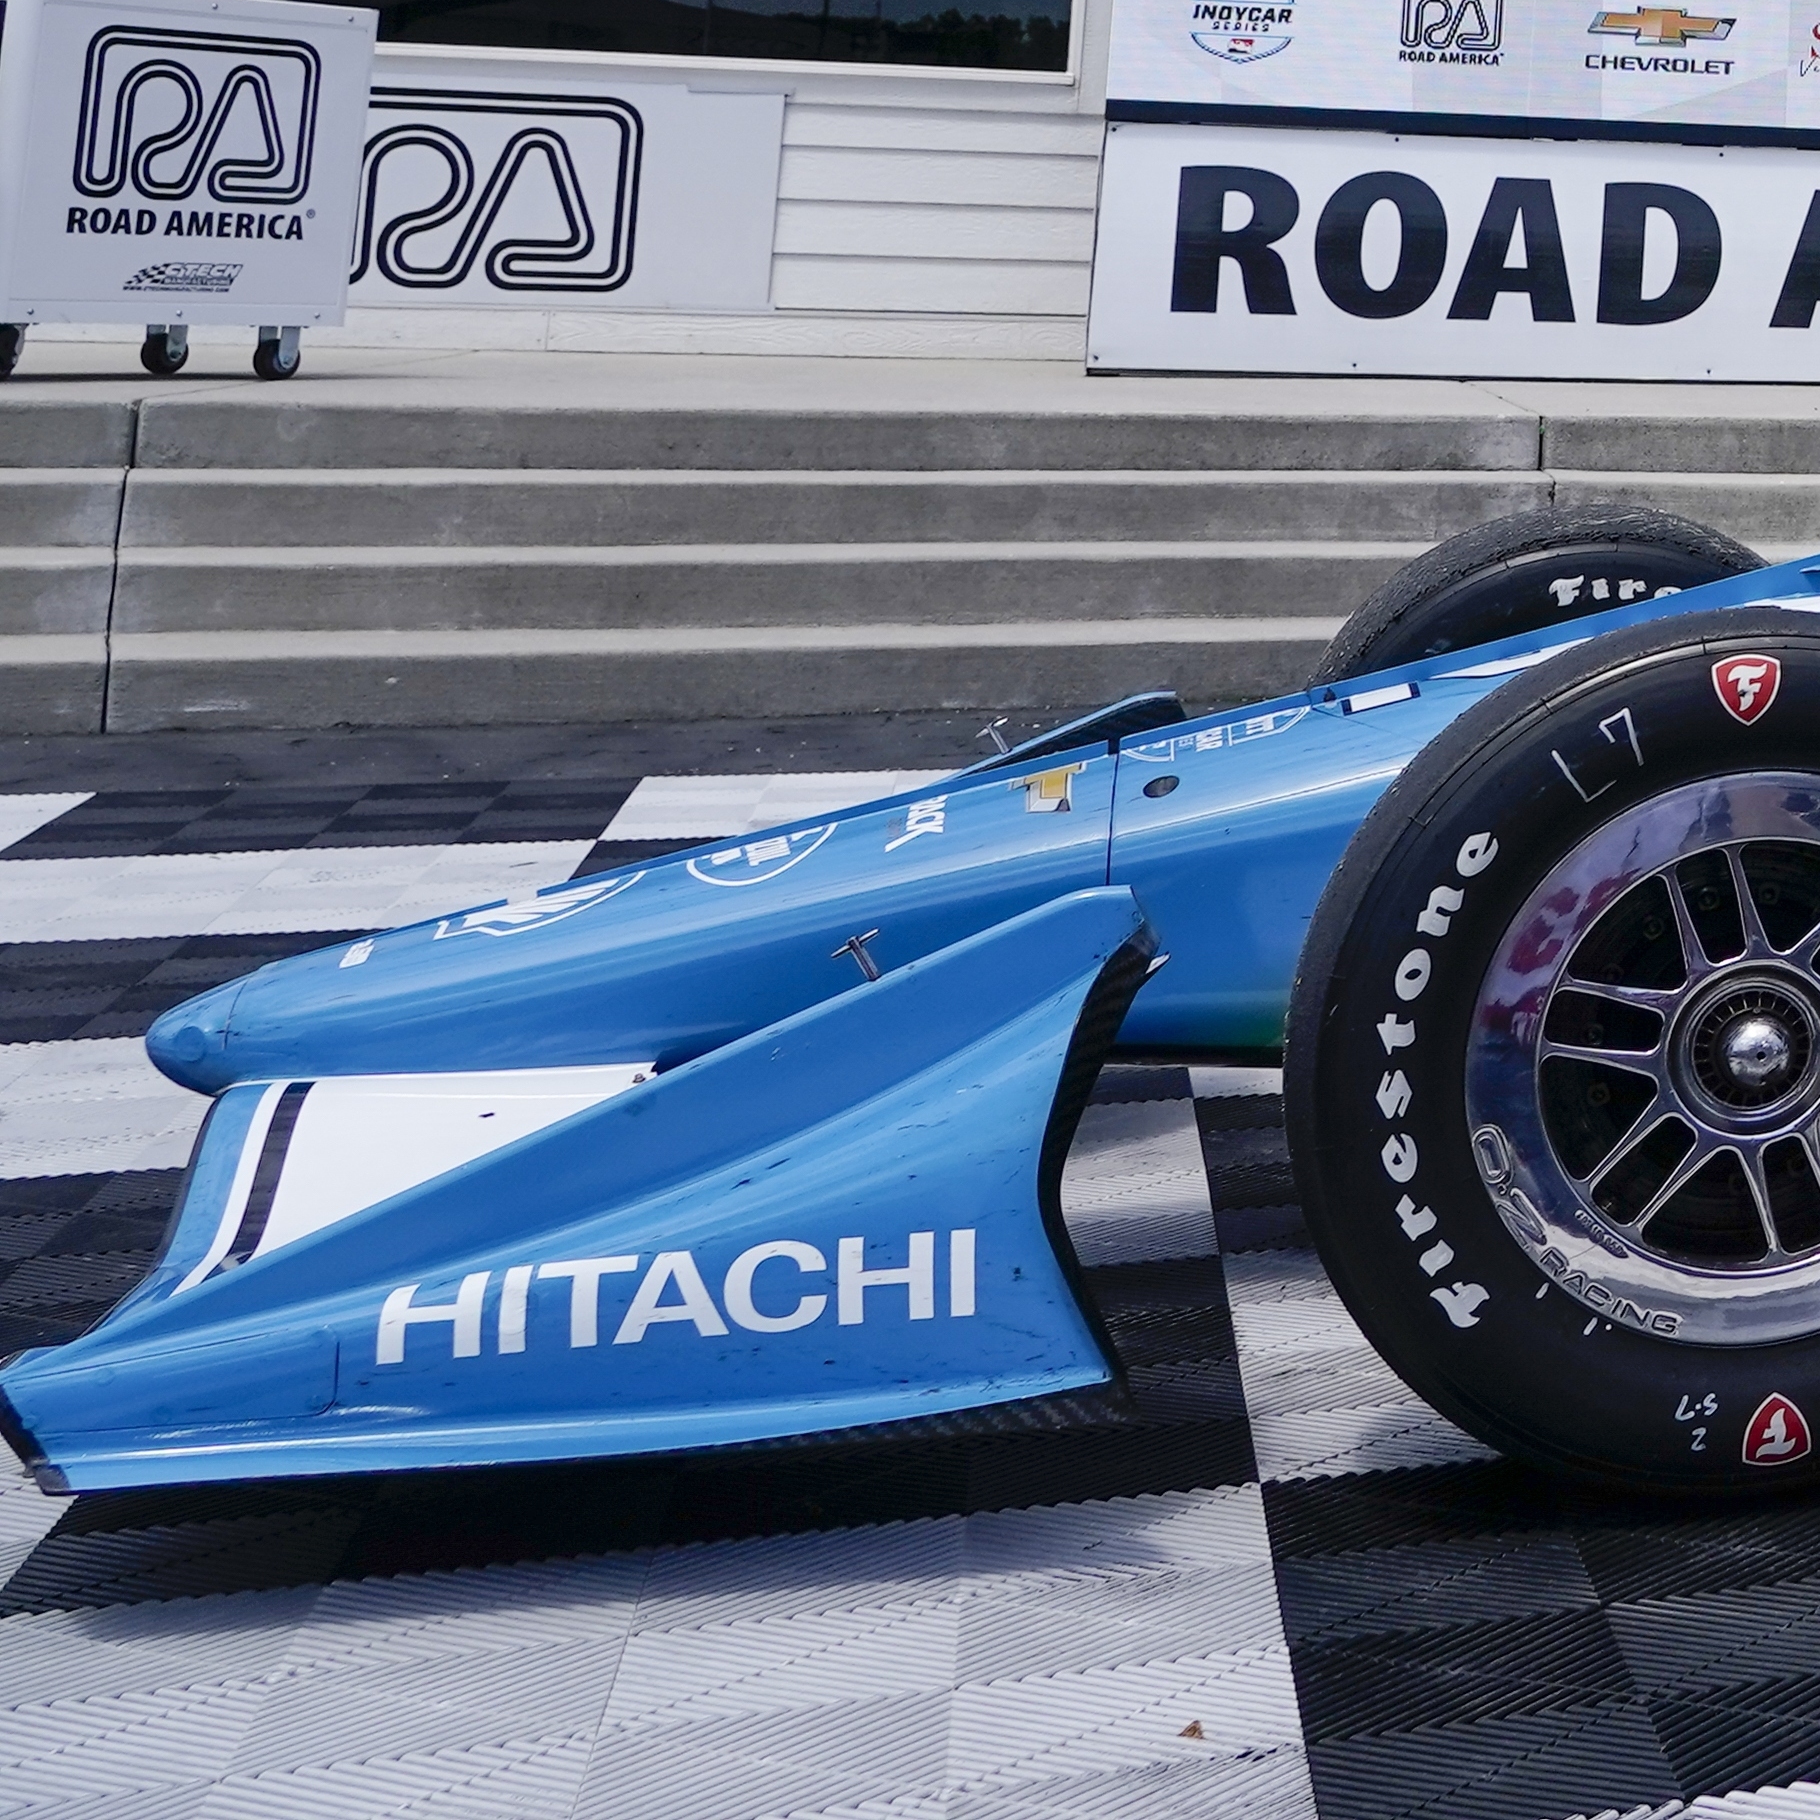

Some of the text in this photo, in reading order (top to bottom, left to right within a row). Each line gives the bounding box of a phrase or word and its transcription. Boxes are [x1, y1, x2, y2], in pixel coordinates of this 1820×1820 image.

[1193, 5, 1292, 24] INDYCAR
[1399, 51, 1499, 66] ROAD AMERICA
[1585, 55, 1734, 74] CHEVROLET
[66, 207, 303, 240] ROAD AMERICA
[1170, 165, 1722, 325] ROAD
[1376, 831, 1500, 1331] Firestone
[376, 1228, 977, 1364] HITACHI
[1539, 1246, 1685, 1338] RACING
